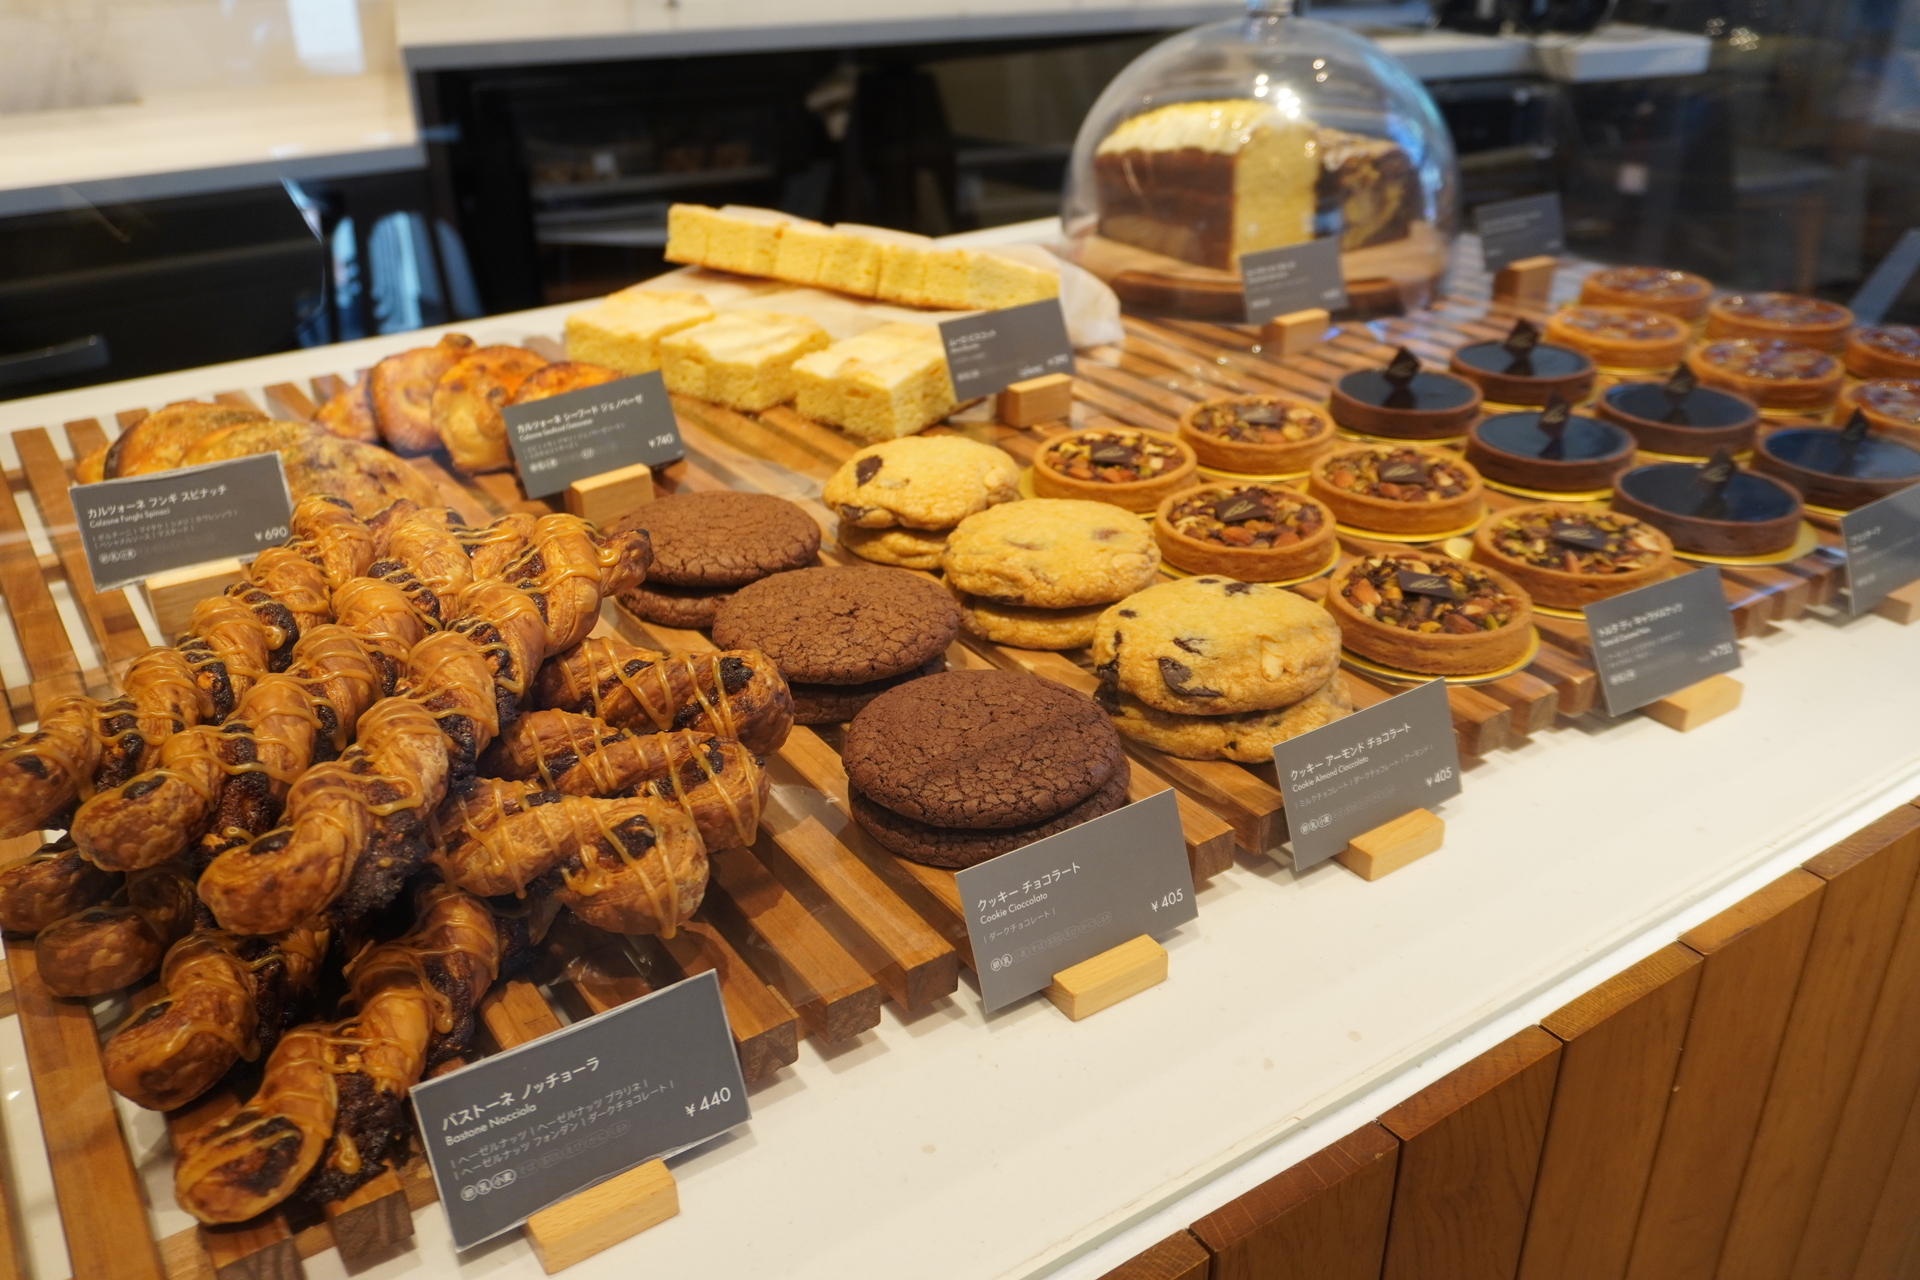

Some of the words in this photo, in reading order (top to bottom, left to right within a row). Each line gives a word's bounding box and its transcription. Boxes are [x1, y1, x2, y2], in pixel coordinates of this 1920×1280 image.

[563, 405, 598, 421] シーフード
[87, 499, 145, 518] カルツォーネ
[148, 492, 177, 507] フンギ
[89, 517, 119, 528] Calzone
[119, 512, 143, 522] Funghi
[144, 507, 170, 518] Spinaci
[1290, 762, 1323, 781] クッキー
[1325, 742, 1364, 766] アーモンド
[1367, 722, 1411, 748] チョコラート
[1292, 779, 1314, 792] Cookie
[1315, 767, 1337, 783] Almond
[1337, 756, 1368, 773] Cioccolato
[977, 889, 1018, 911] クッキー
[1022, 862, 1080, 893] チョコラート
[979, 909, 1007, 924] Cookie
[1007, 892, 1047, 913] Cioccolato
[988, 910, 1050, 941] ダークチョコレート
[442, 1092, 515, 1130] バストーネ
[521, 1056, 599, 1099] ノッチョーラ
[444, 1124, 487, 1146] Bastone
[488, 1103, 536, 1128] Nocciola
[458, 1130, 526, 1163] ヘーゼルナッツ
[536, 1098, 602, 1130] ヘーゼルナッツ
[461, 1141, 529, 1175] ヘーゼルナッツ
